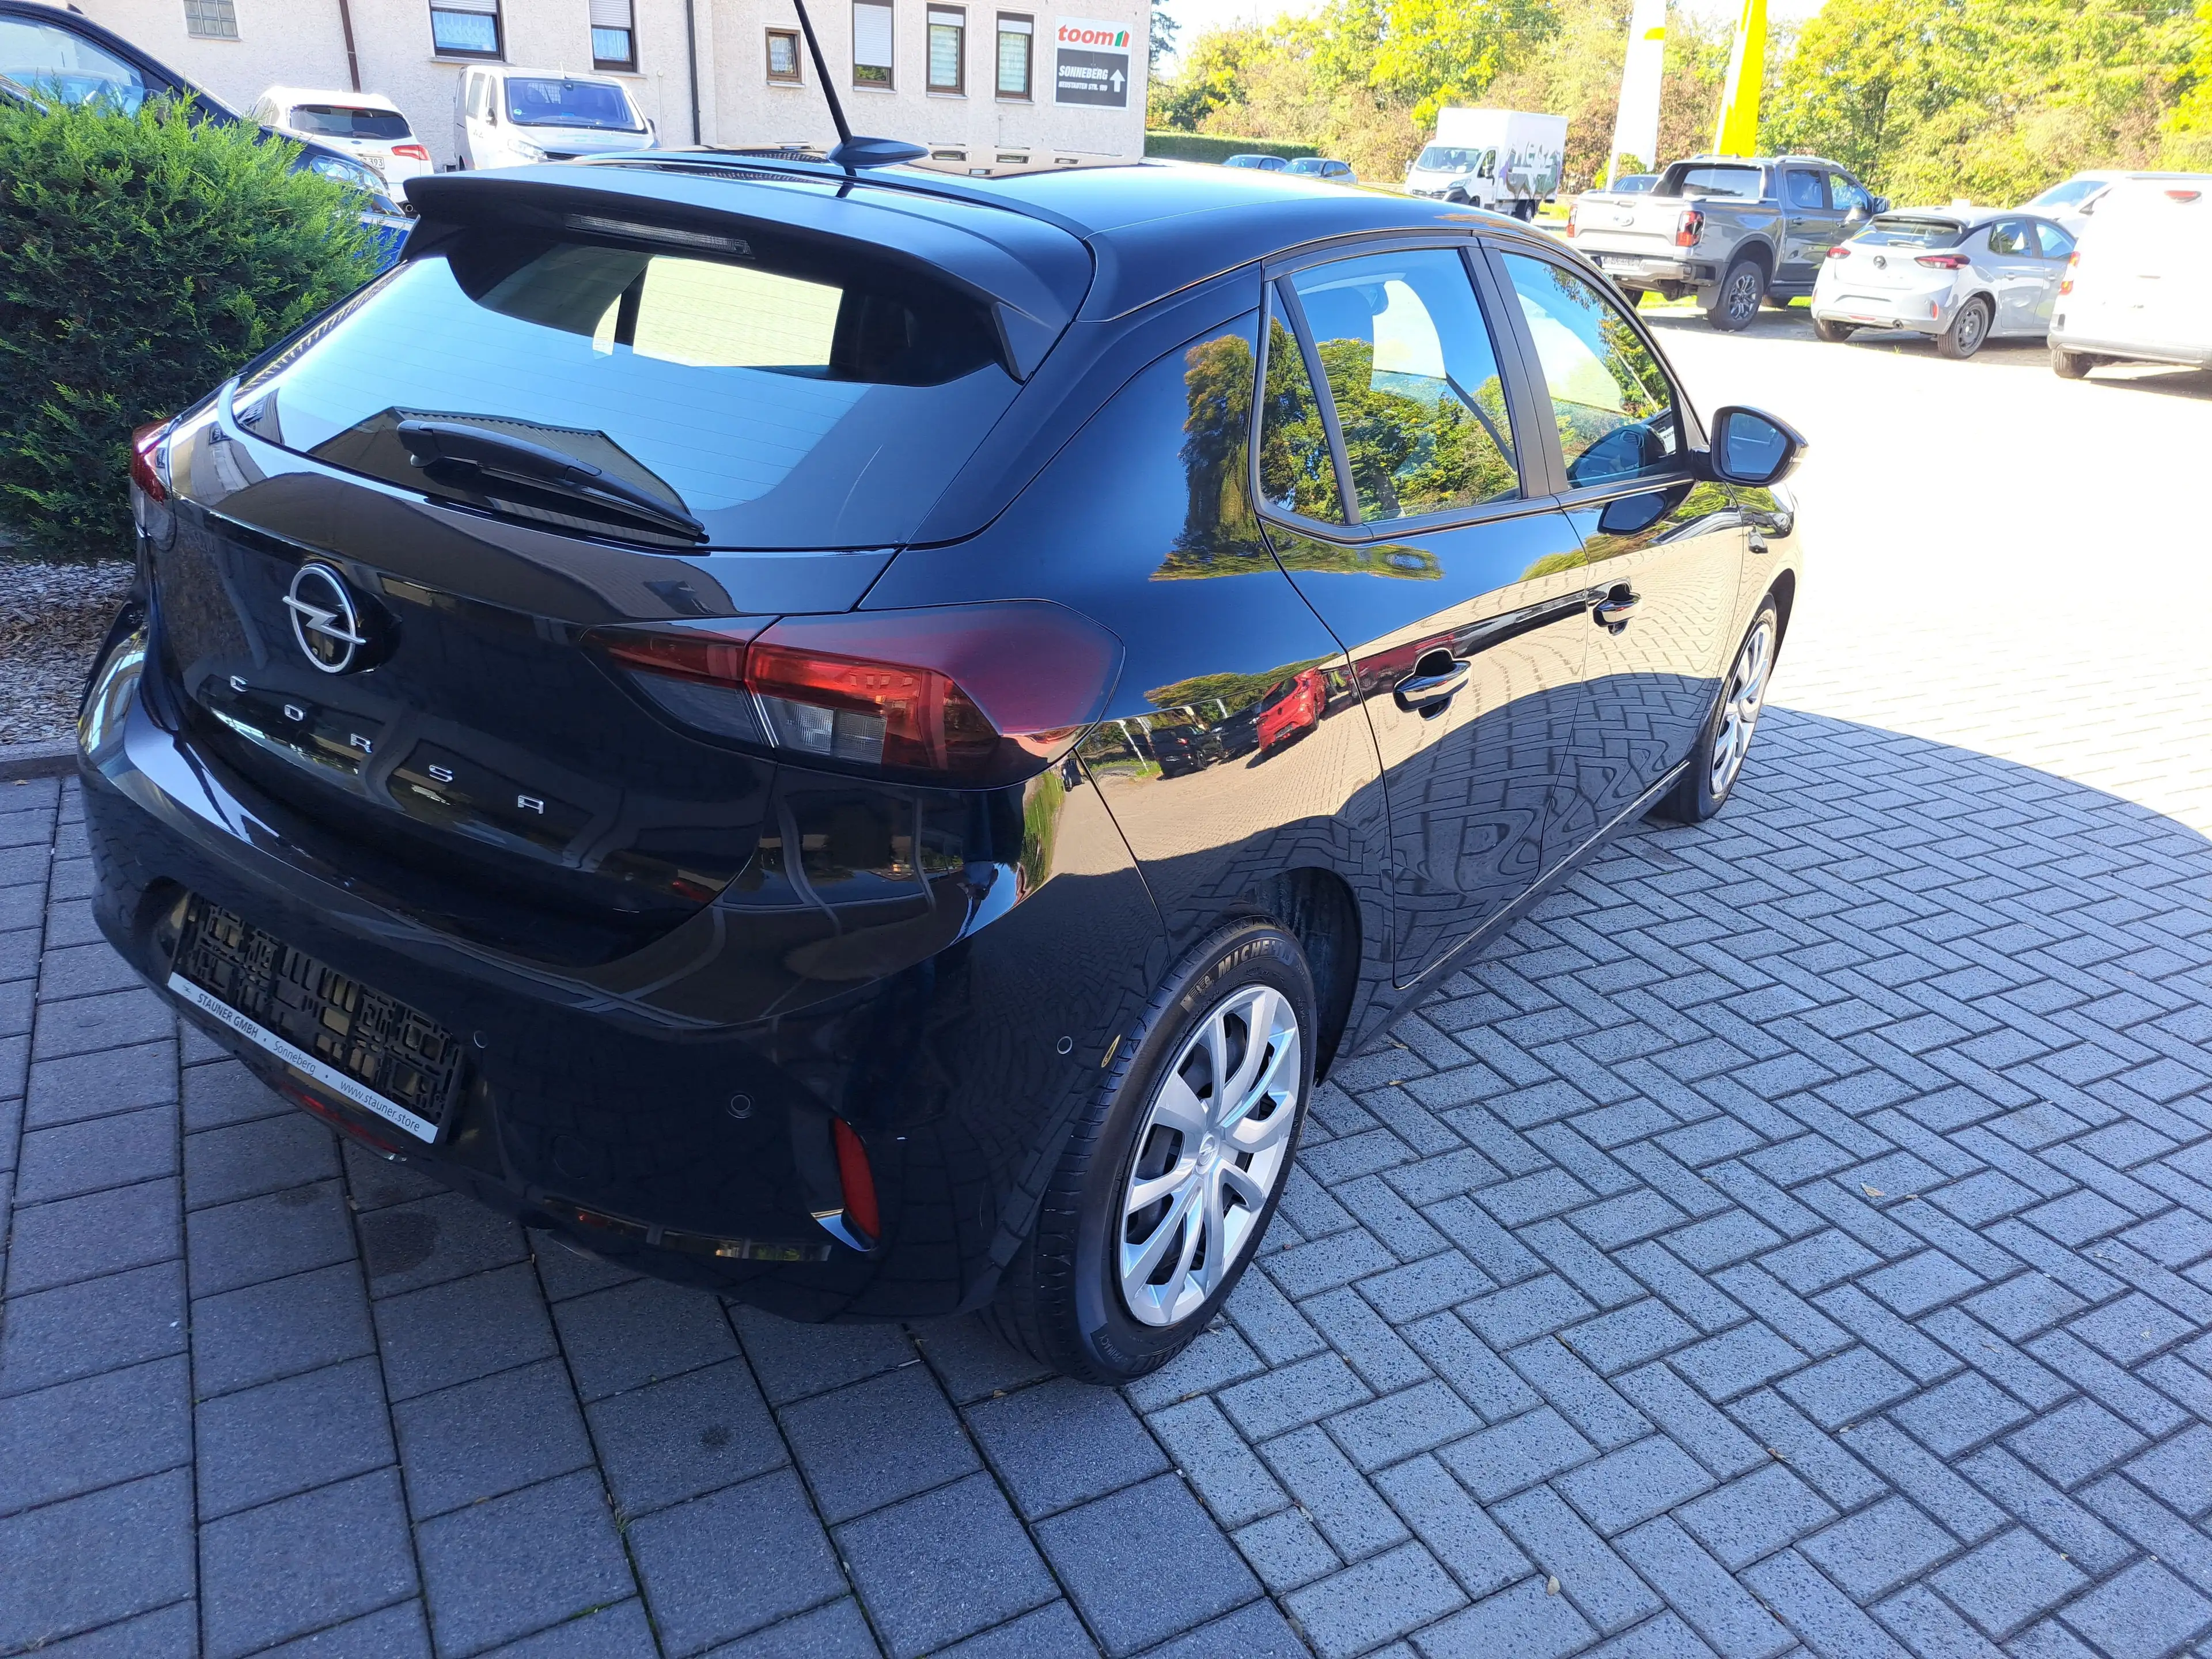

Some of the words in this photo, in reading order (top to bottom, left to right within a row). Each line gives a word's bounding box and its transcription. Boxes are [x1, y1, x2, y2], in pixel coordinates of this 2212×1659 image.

[1058, 24, 1114, 46] toom
[1059, 65, 1108, 80] SONNEBERG
[230, 675, 544, 815] CORSA
[1218, 940, 1294, 979] MICHELIN
[197, 993, 233, 1022] STAUNER
[233, 1016, 259, 1038] GMBH
[273, 1041, 316, 1075] Sonneberg
[340, 1080, 420, 1132] www.stauner.store
